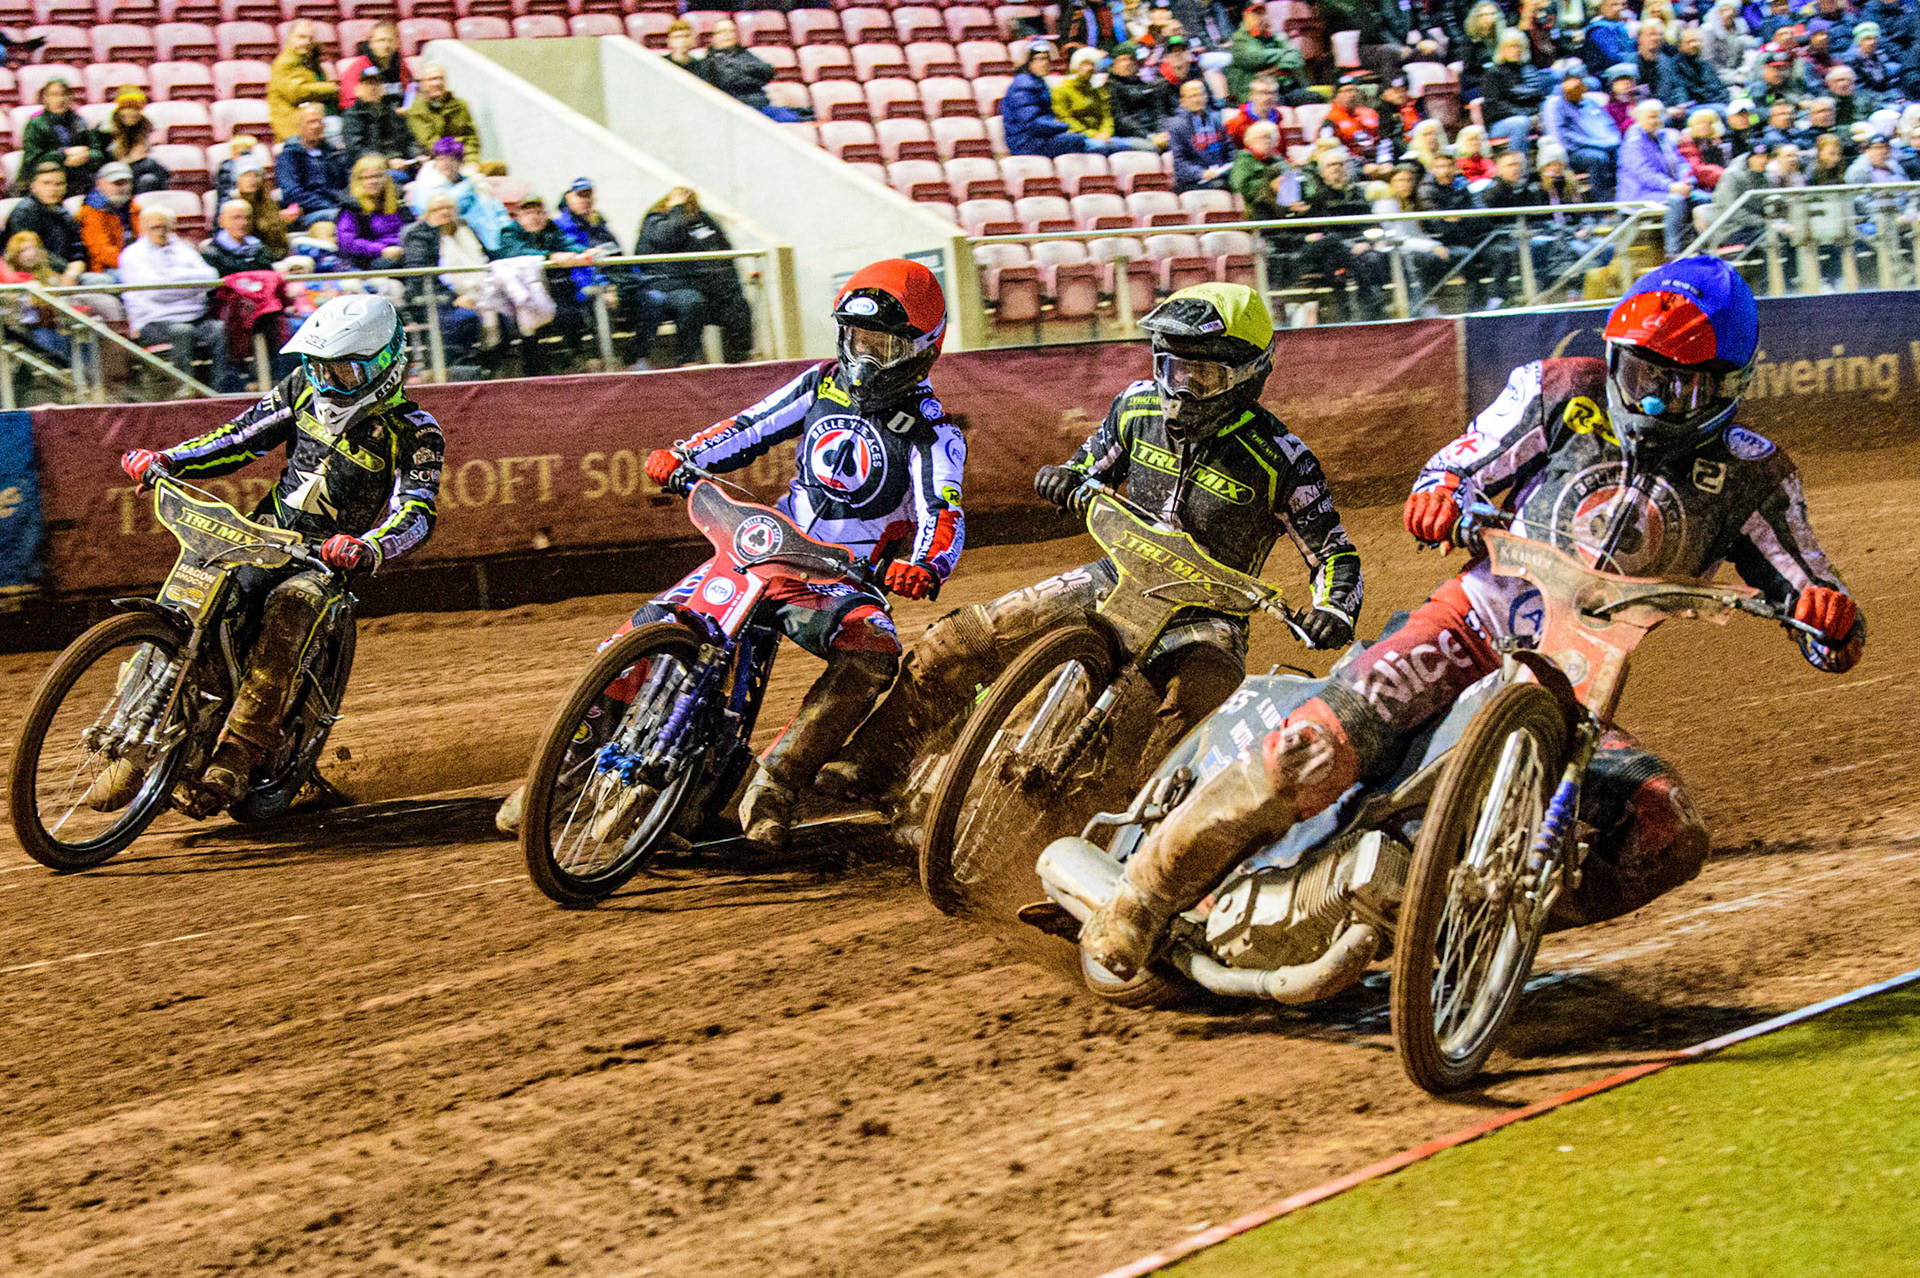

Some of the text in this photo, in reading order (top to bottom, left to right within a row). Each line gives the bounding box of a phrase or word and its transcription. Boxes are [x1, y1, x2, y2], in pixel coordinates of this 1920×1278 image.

[812, 419, 845, 440] BELLE
[867, 439, 882, 468] ACES
[1191, 467, 1246, 500] MIX
[183, 512, 258, 546] TRU MIX
[177, 563, 217, 584] HAGON
